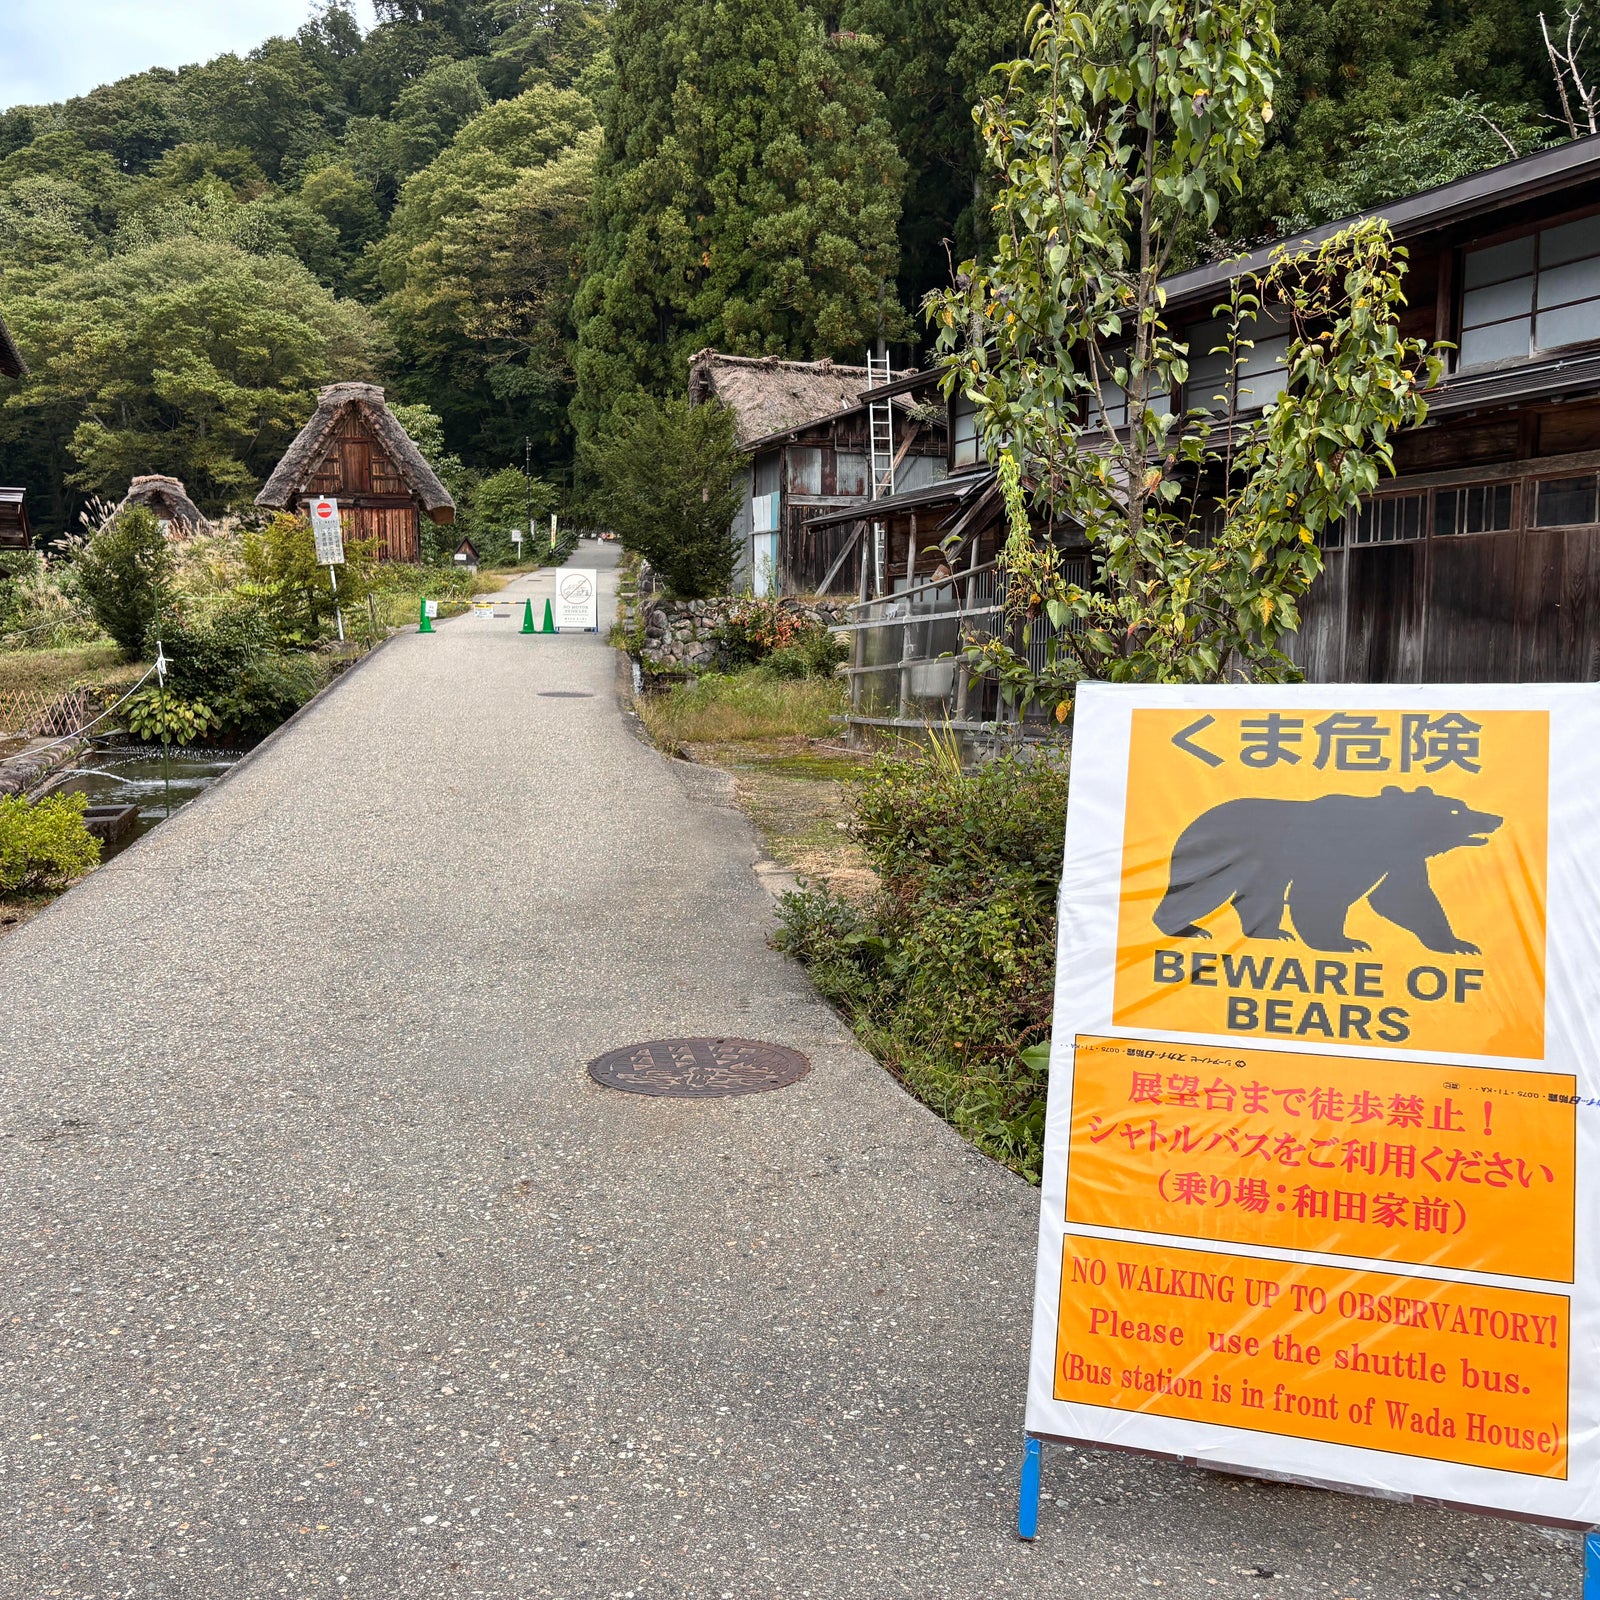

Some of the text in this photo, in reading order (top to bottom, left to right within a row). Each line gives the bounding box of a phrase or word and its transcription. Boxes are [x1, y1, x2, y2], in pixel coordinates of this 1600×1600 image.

[1173, 714, 1483, 773] くま危険
[1154, 949, 1484, 1003] BEWARE OF
[1227, 997, 1410, 1043] BEARS
[1128, 1071, 1494, 1136] 展望台まで徒歩禁止！
[1088, 1115, 1555, 1189] シャトルバスをご利用ください
[1071, 1257, 1557, 1349] NO WALKING UP TO OBSERVATORY!
[1088, 1307, 1531, 1395] Please use the shuttle bus.
[1062, 1351, 1559, 1457] (Bus station is in front of Wada House)
